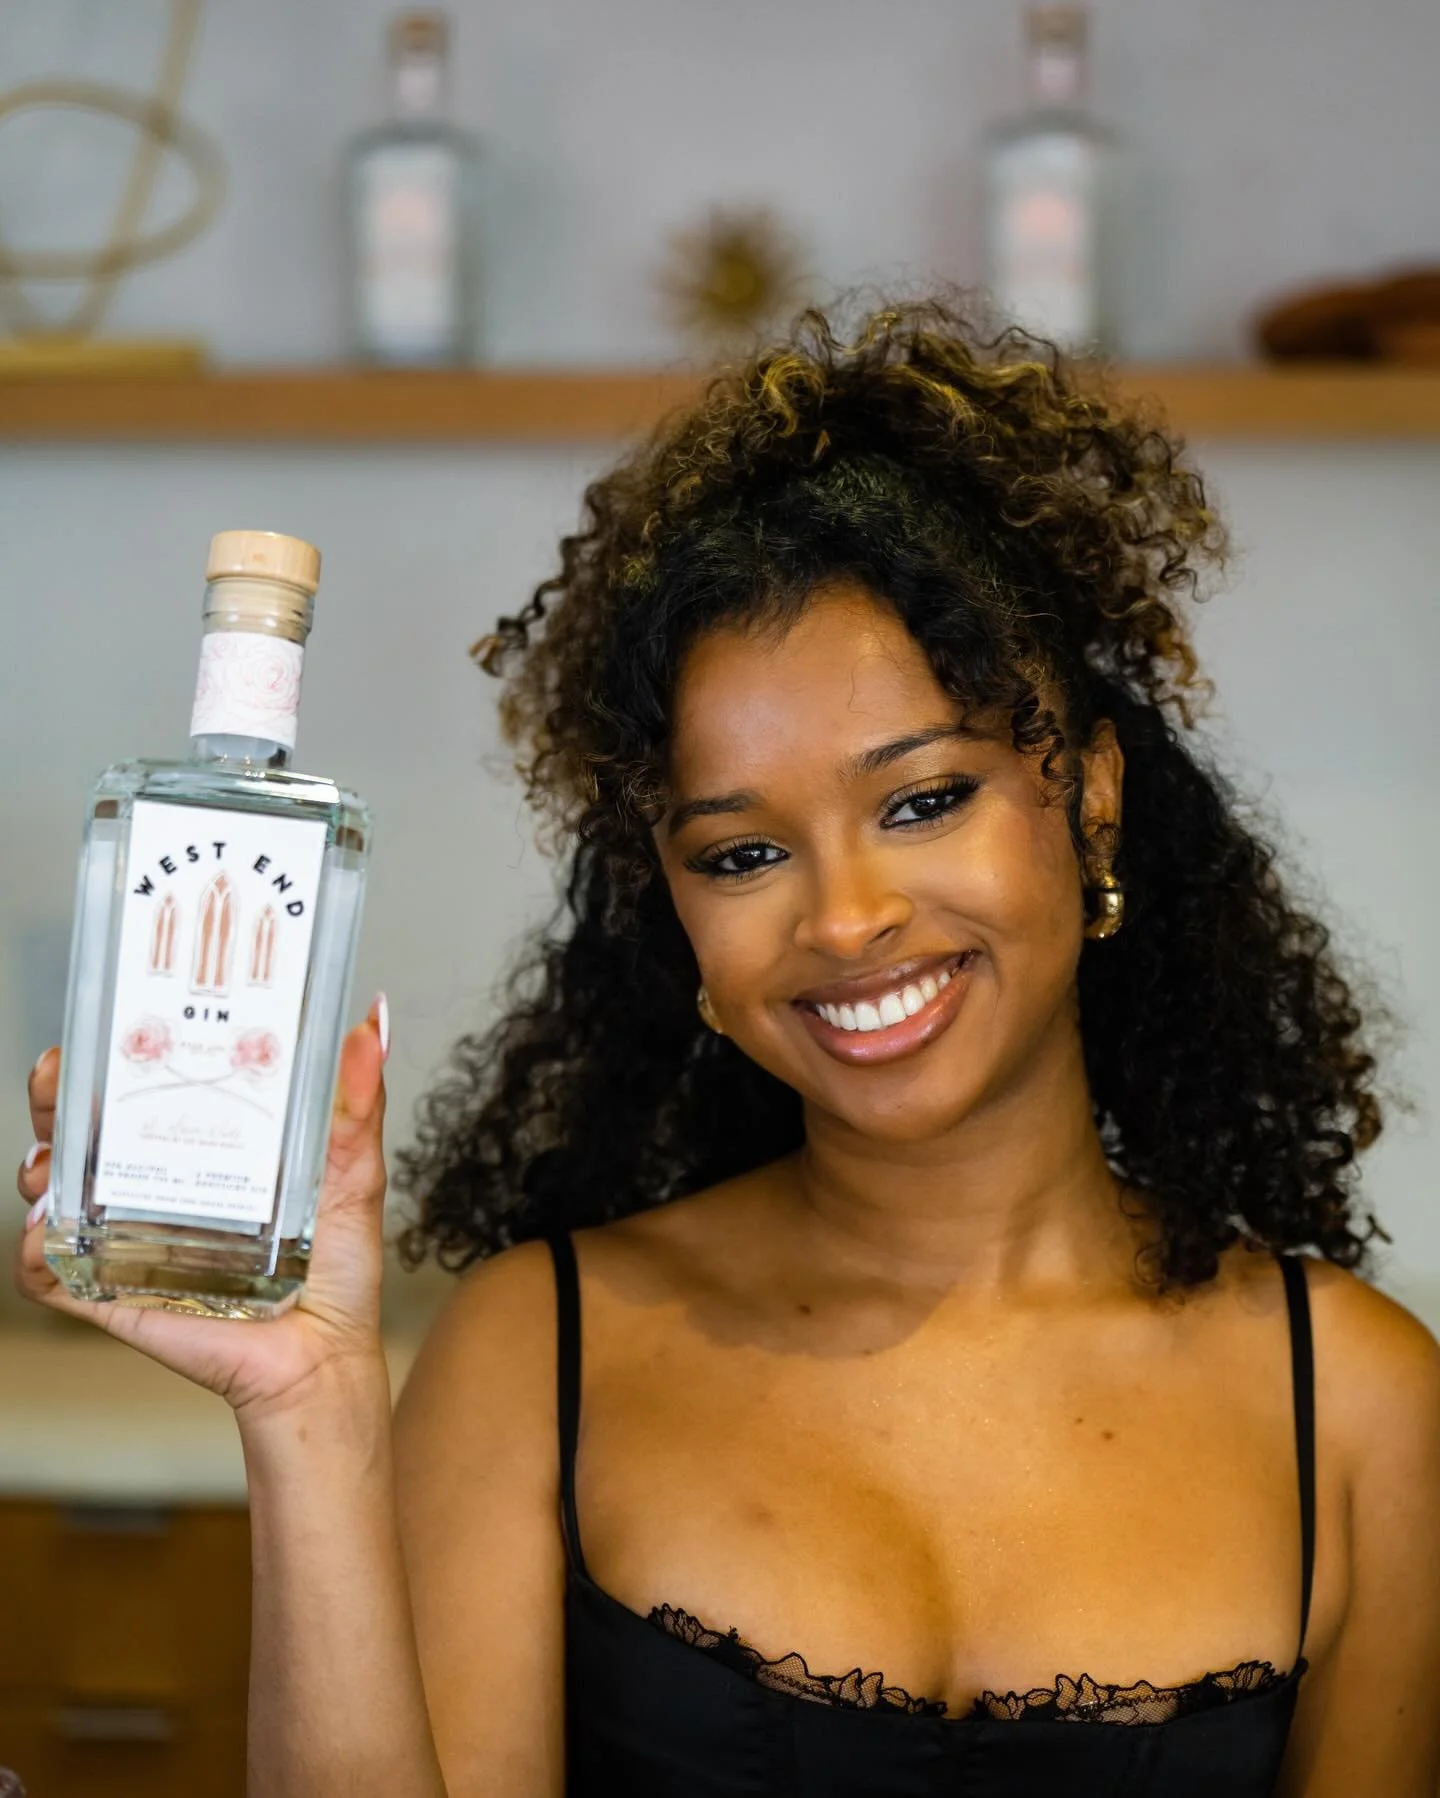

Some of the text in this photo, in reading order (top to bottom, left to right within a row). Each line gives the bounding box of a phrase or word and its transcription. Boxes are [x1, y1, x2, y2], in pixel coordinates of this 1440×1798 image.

[134, 842, 304, 917] WEST END
[184, 1006, 229, 1022] GIN
